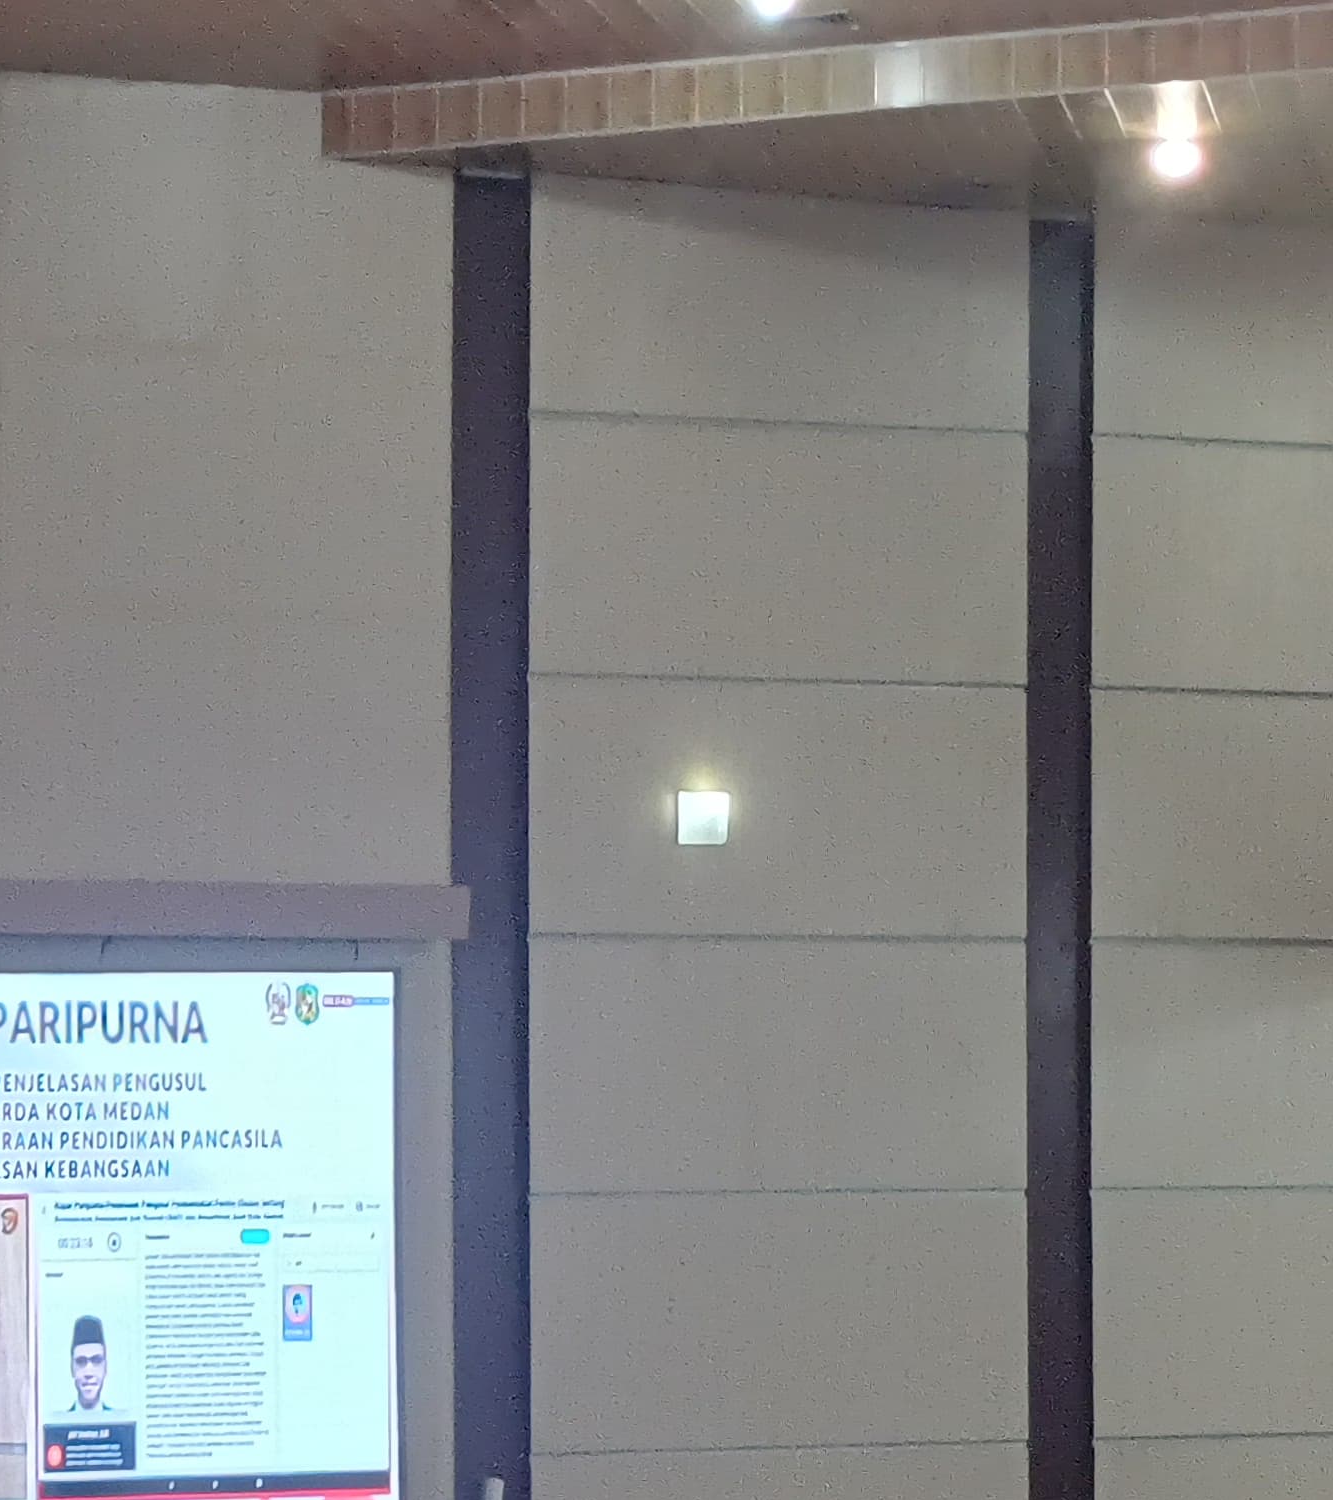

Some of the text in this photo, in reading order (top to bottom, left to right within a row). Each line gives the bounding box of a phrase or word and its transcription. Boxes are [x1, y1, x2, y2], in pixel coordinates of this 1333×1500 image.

[113, 1072, 207, 1093] PENGUSUL
[46, 1101, 97, 1122] KOTA
[103, 1101, 169, 1121] MEDAN
[59, 1130, 175, 1151] PENDIDIKAN
[181, 1129, 283, 1150] PANCASILA
[44, 1159, 170, 1179] KEBANGSAAN
